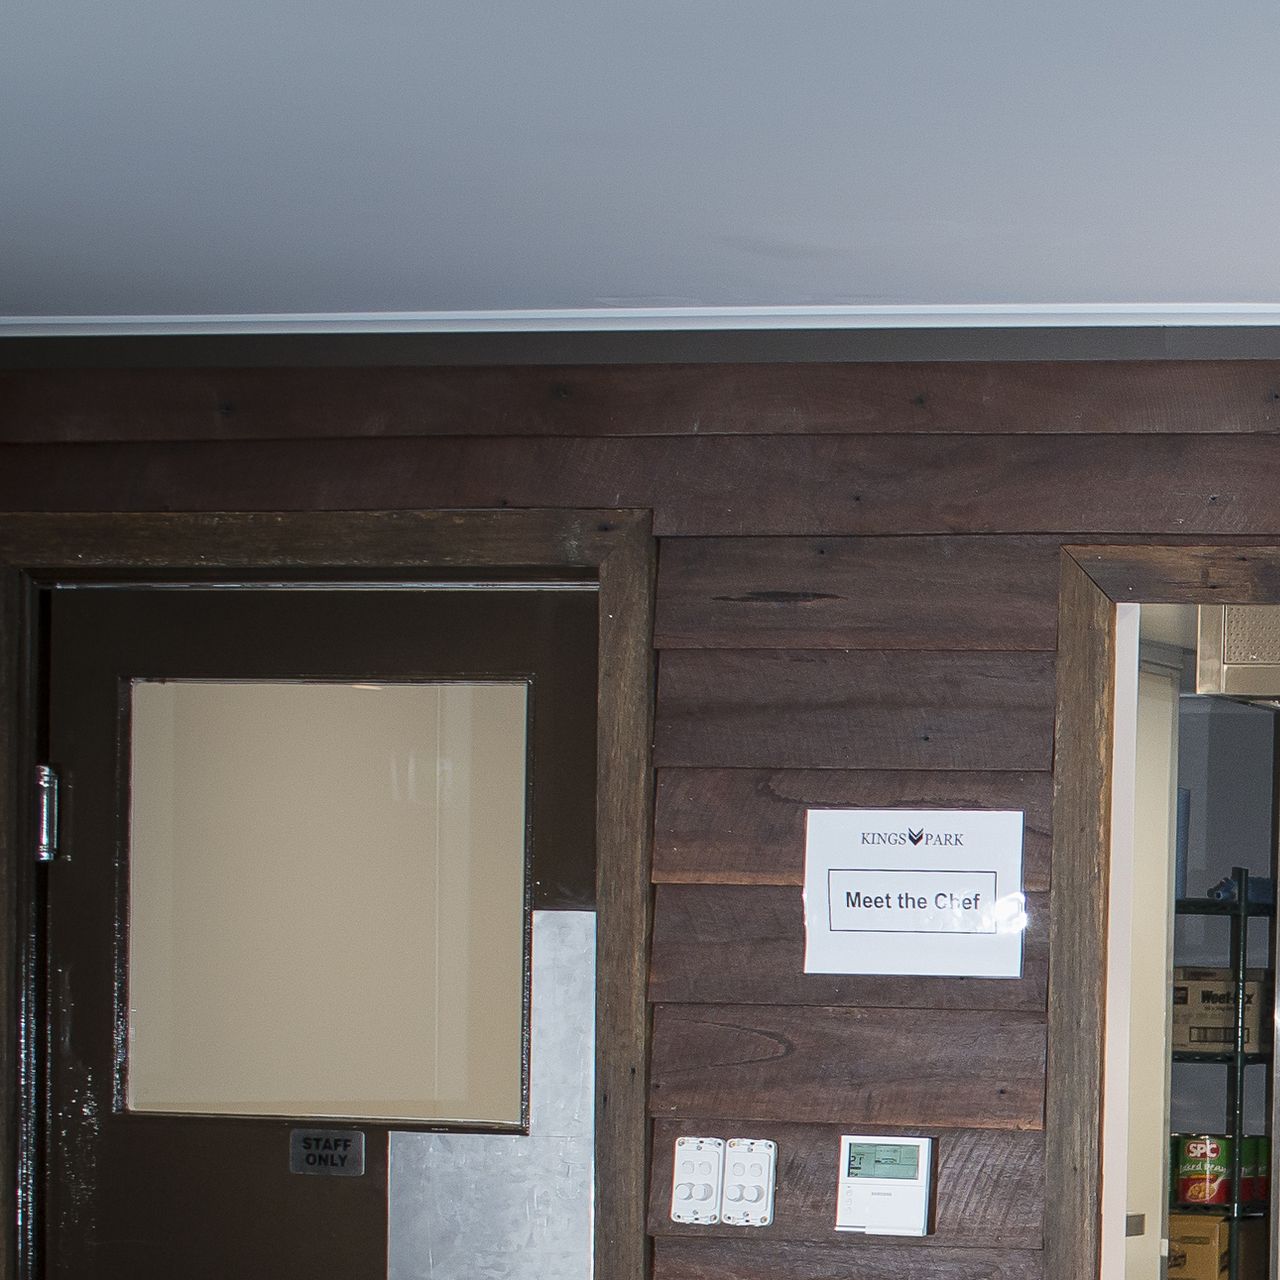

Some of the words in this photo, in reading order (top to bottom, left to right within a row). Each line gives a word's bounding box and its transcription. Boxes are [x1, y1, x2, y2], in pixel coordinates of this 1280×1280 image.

[861, 832, 907, 845] KINGS
[925, 834, 964, 846] PARK
[846, 891, 892, 908] Meet
[897, 893, 927, 909] the
[934, 893, 980, 910] Chef
[303, 1138, 351, 1151] STAFF
[1189, 1143, 1218, 1158] SPC
[306, 1154, 348, 1167] ONLY
